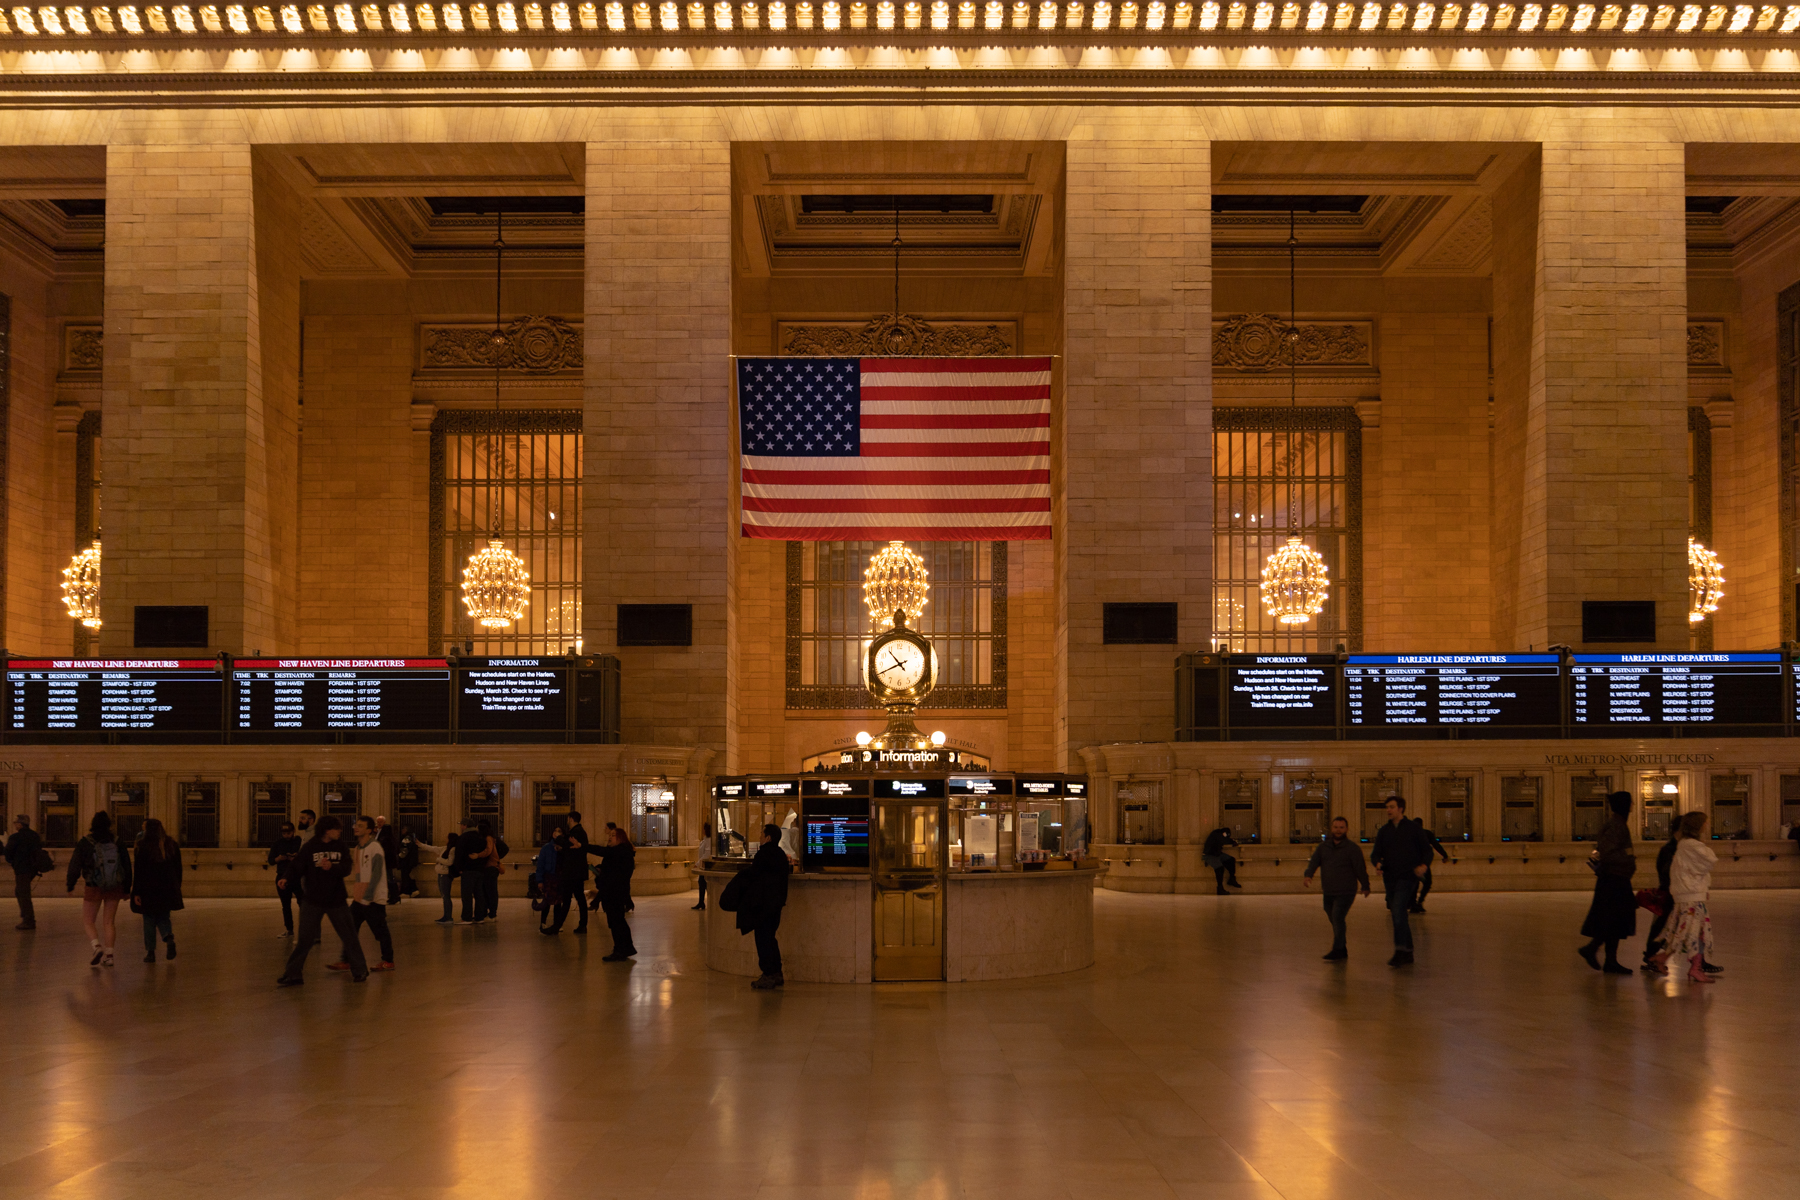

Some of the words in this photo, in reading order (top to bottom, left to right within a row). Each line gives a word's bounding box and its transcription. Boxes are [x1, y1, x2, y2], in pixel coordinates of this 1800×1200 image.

[53, 660, 73, 668] NEW
[74, 660, 103, 668] HAVEN
[105, 660, 125, 668] LINE
[126, 660, 179, 668] DEPARTURES
[833, 737, 851, 745] 42ND
[959, 740, 977, 749] HALL
[880, 751, 938, 761] Information
[1545, 755, 1570, 764] MTA
[1574, 754, 1663, 764] METRO-NORTH
[1666, 754, 1715, 763] TICKETS
[0, 761, 24, 770] INES
